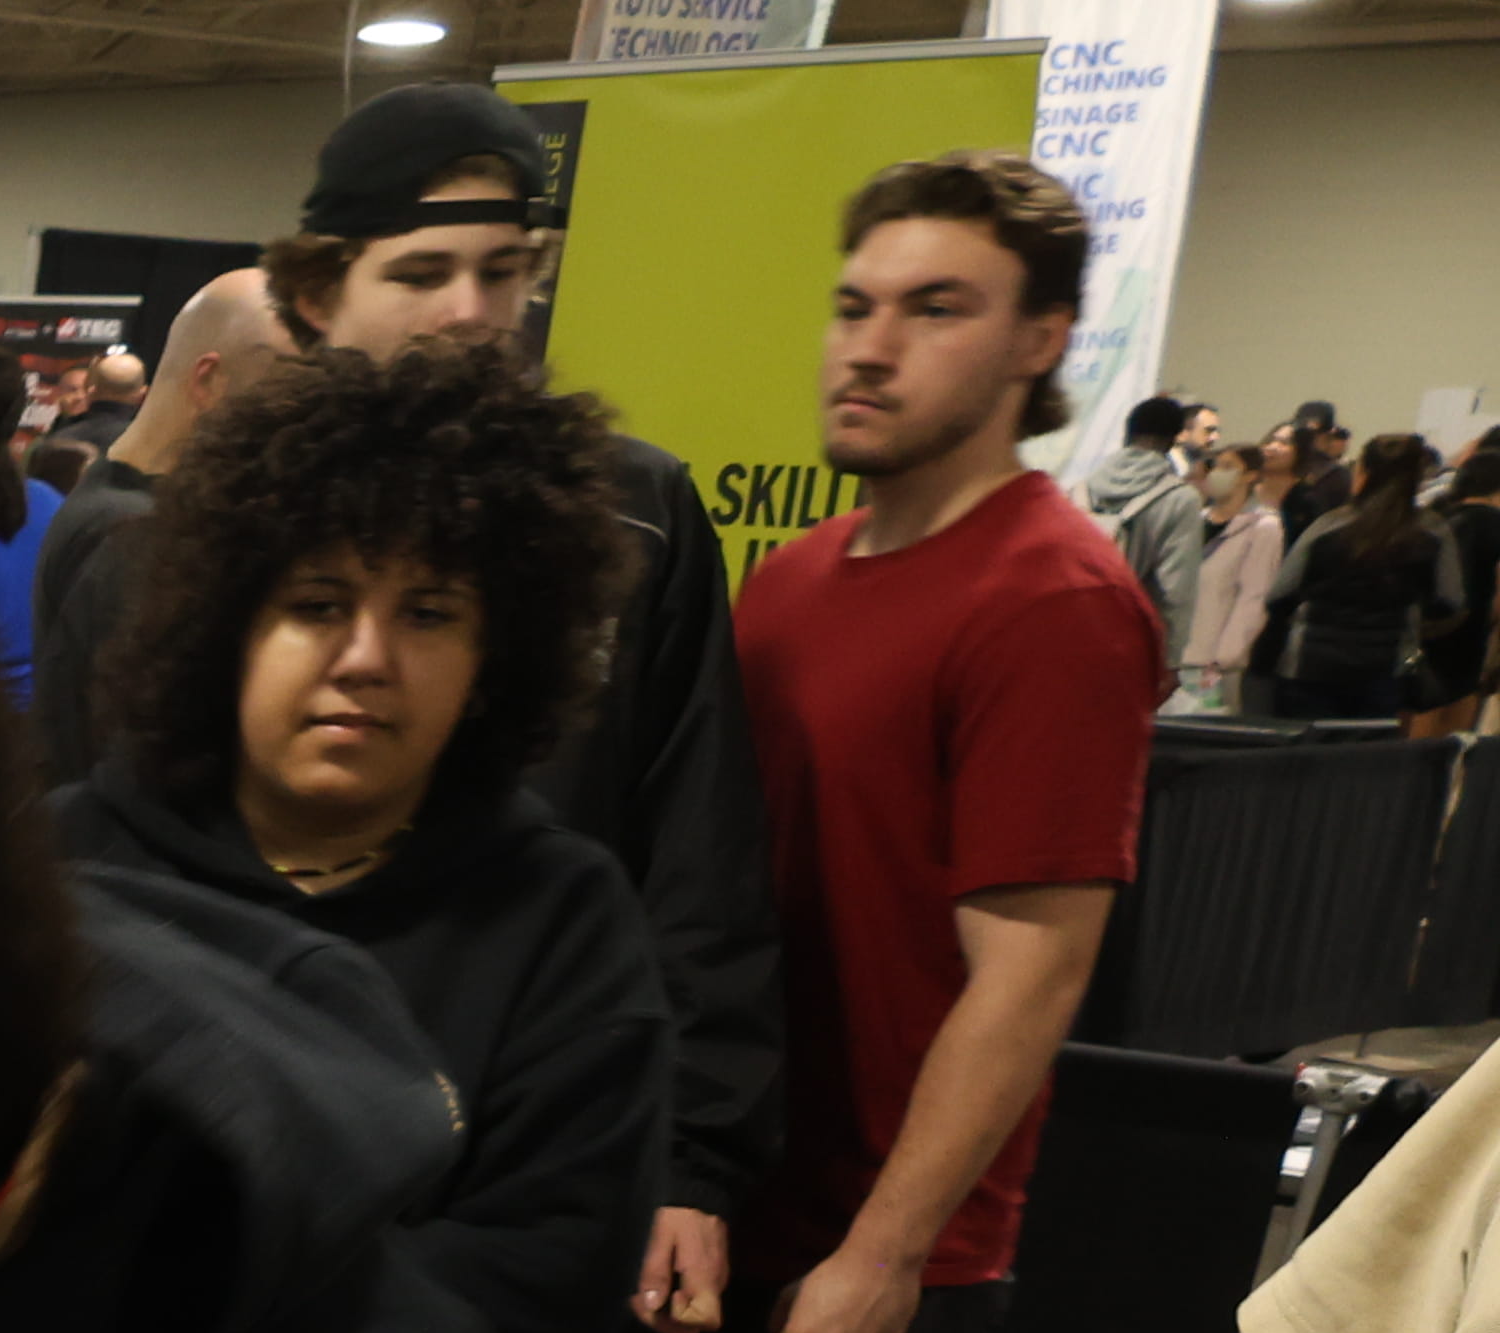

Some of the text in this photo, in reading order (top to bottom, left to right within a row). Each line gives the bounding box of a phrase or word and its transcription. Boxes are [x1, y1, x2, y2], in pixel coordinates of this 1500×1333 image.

[1050, 39, 1126, 70] CNC
[1043, 66, 1167, 95] CHINING
[1036, 102, 1140, 129] SINAGE
[1037, 130, 1109, 159] CNC
